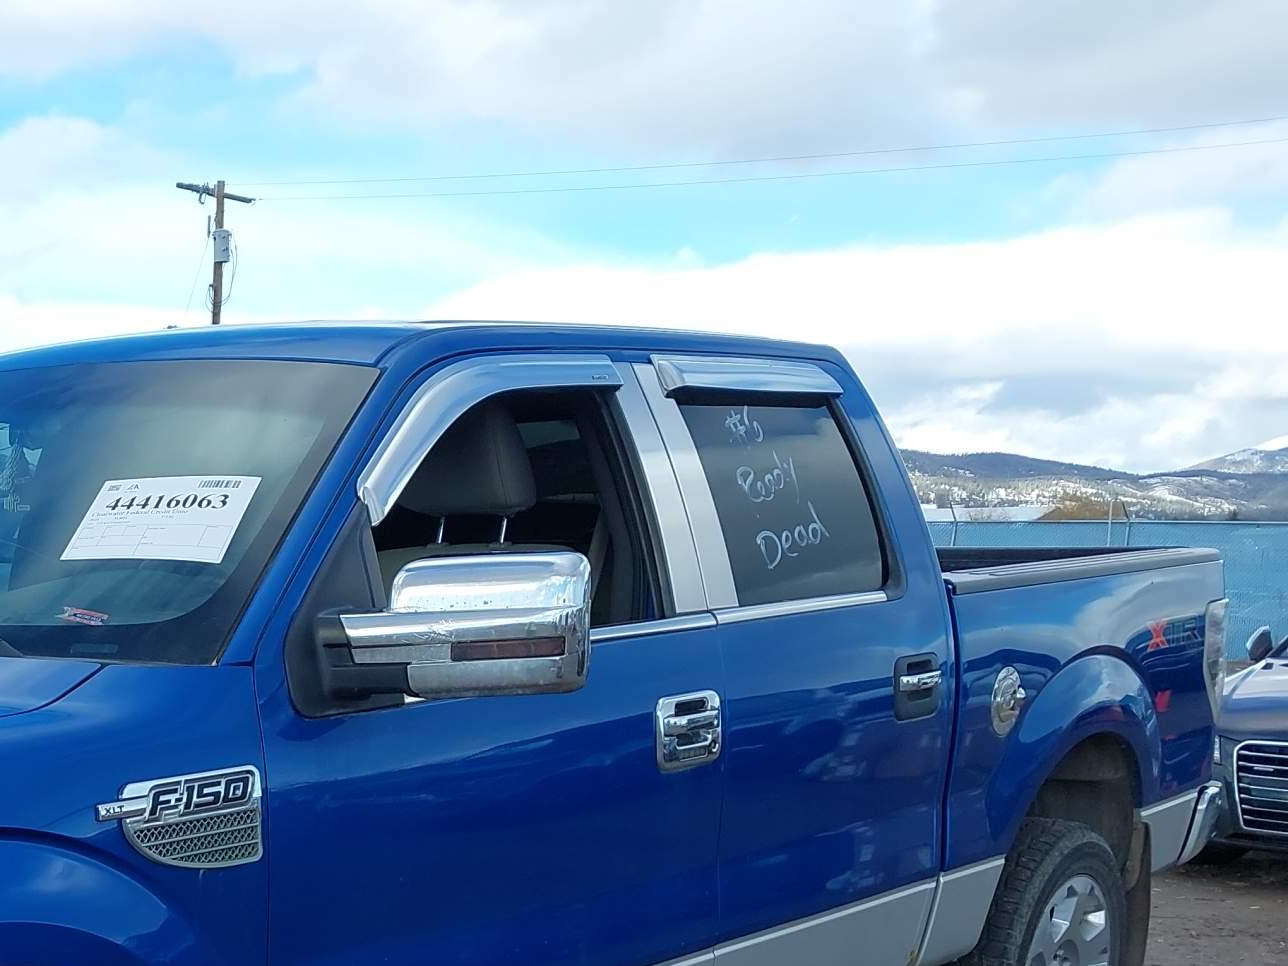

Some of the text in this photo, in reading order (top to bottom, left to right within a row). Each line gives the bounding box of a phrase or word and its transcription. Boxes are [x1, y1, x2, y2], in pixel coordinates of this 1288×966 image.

[106, 493, 230, 511] 44416063
[756, 500, 830, 569] Dead
[103, 804, 125, 816] XLT
[148, 774, 252, 818] F-150
